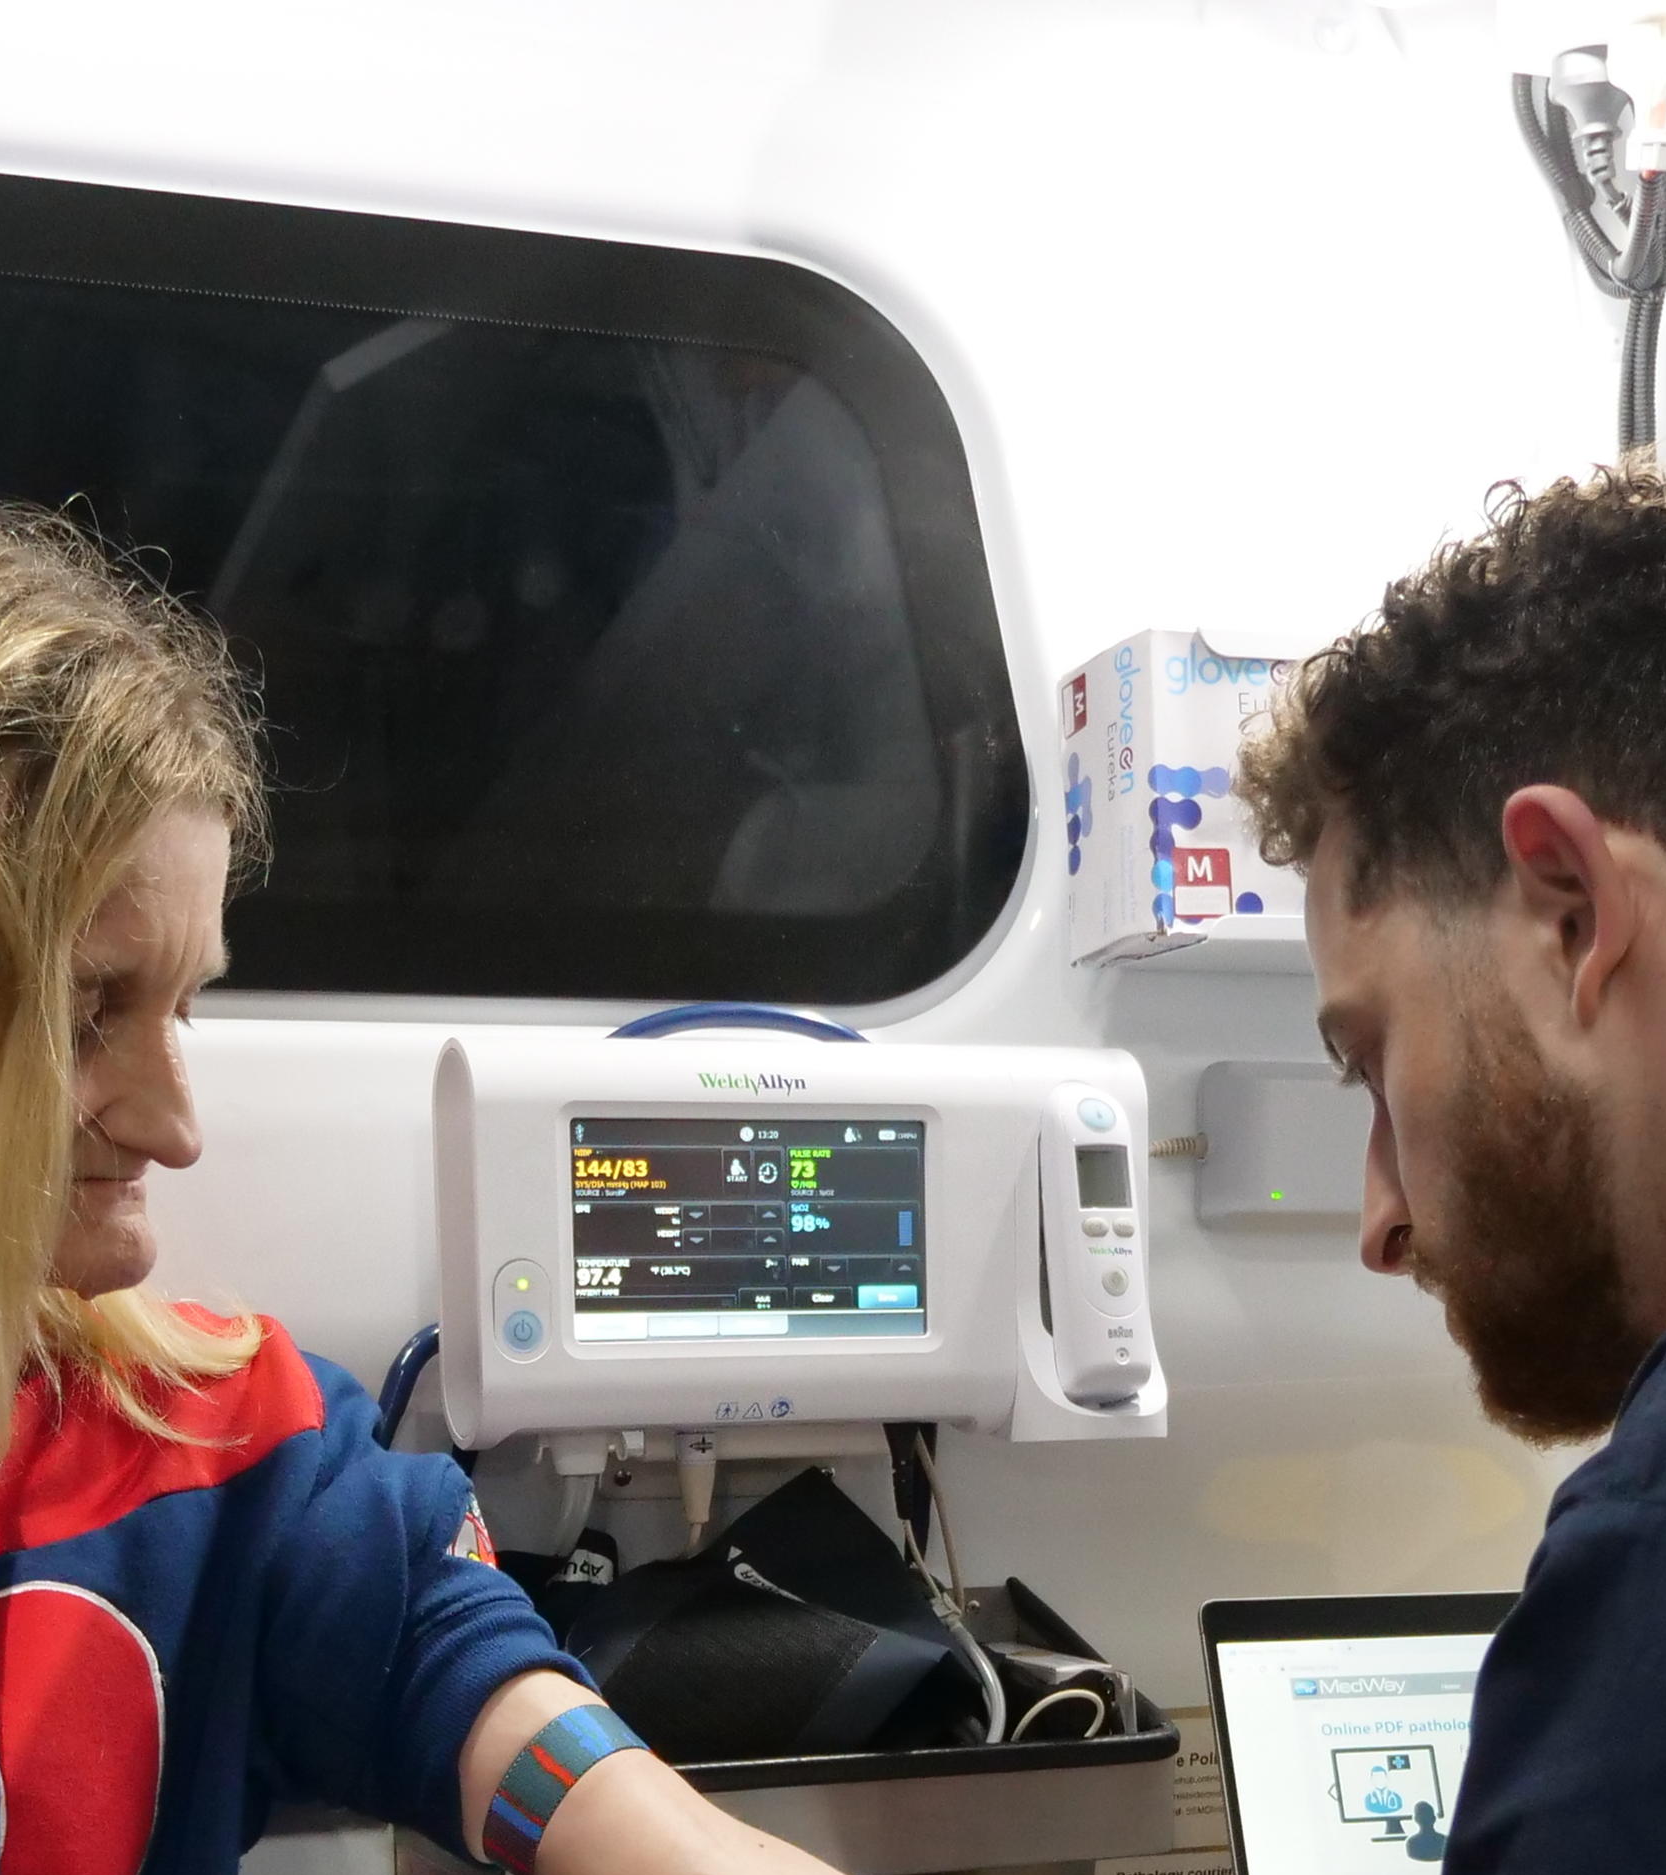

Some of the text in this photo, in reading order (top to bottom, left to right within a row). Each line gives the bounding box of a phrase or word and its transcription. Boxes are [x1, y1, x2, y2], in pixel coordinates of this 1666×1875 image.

[1074, 693, 1084, 717] M
[1107, 722, 1117, 802] Eureka
[1187, 855, 1214, 882] M
[758, 1130, 779, 1140] 13:20
[575, 1159, 649, 1181] 144/83
[790, 1160, 816, 1178] 73
[576, 1267, 623, 1287] 97.4
[1319, 1677, 1406, 1695] MedWay
[1321, 1721, 1371, 1737] Online
[1374, 1720, 1403, 1734] PDF
